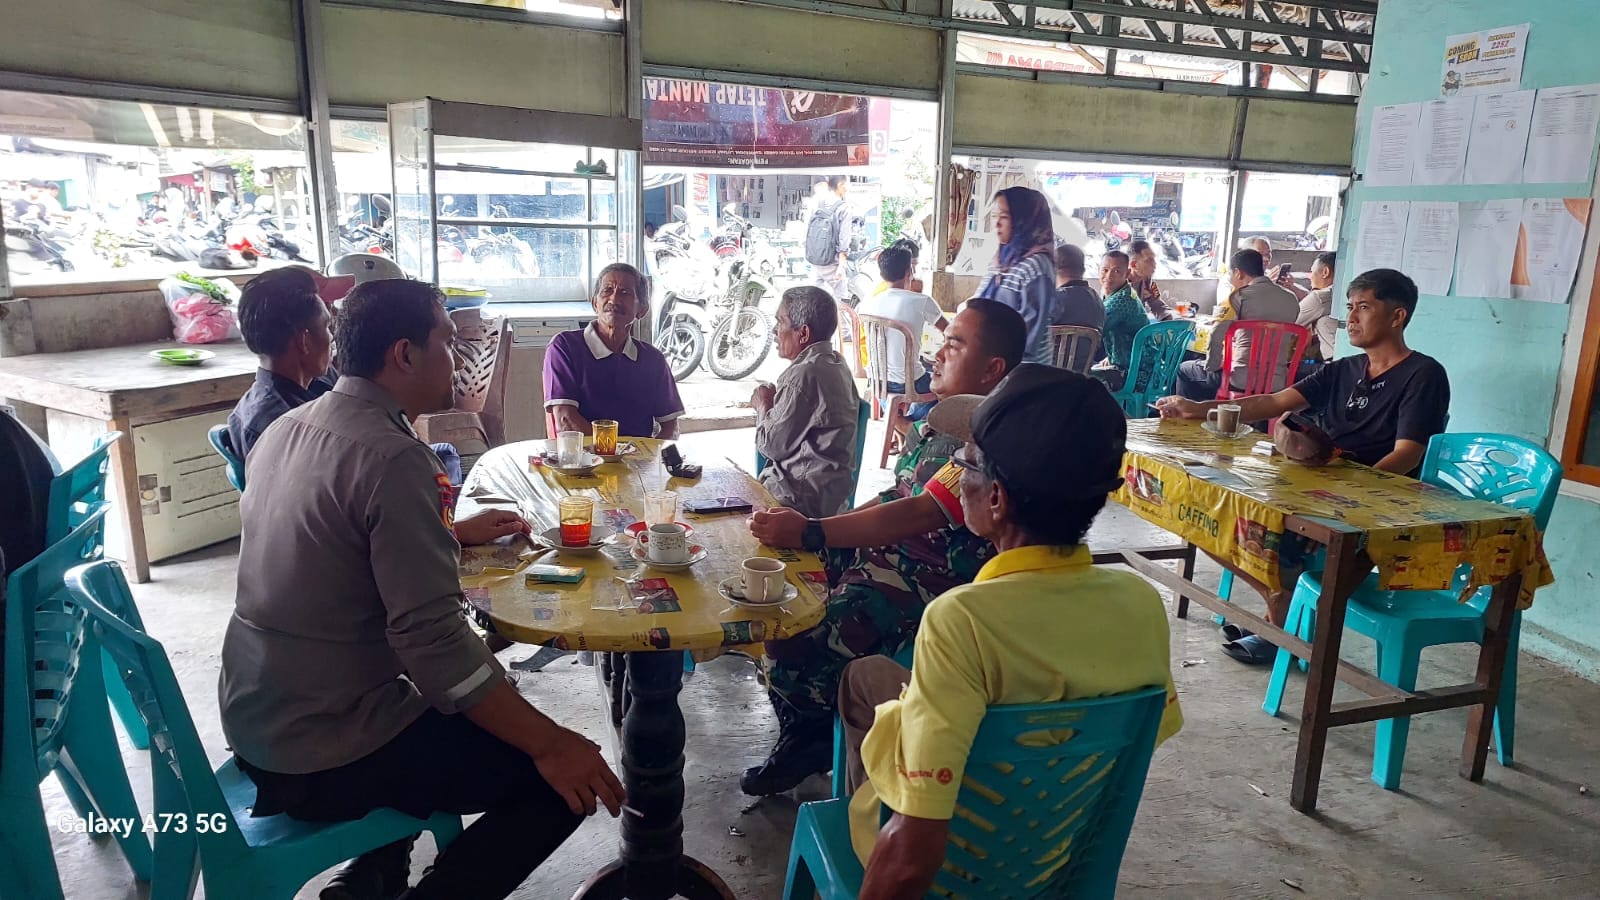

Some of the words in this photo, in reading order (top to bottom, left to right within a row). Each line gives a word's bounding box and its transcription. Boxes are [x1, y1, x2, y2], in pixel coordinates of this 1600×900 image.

[1448, 42, 1476, 56] COMING
[642, 78, 711, 103] MANTA
[715, 85, 767, 107] TETAP
[1177, 503, 1220, 538] CAFFINO
